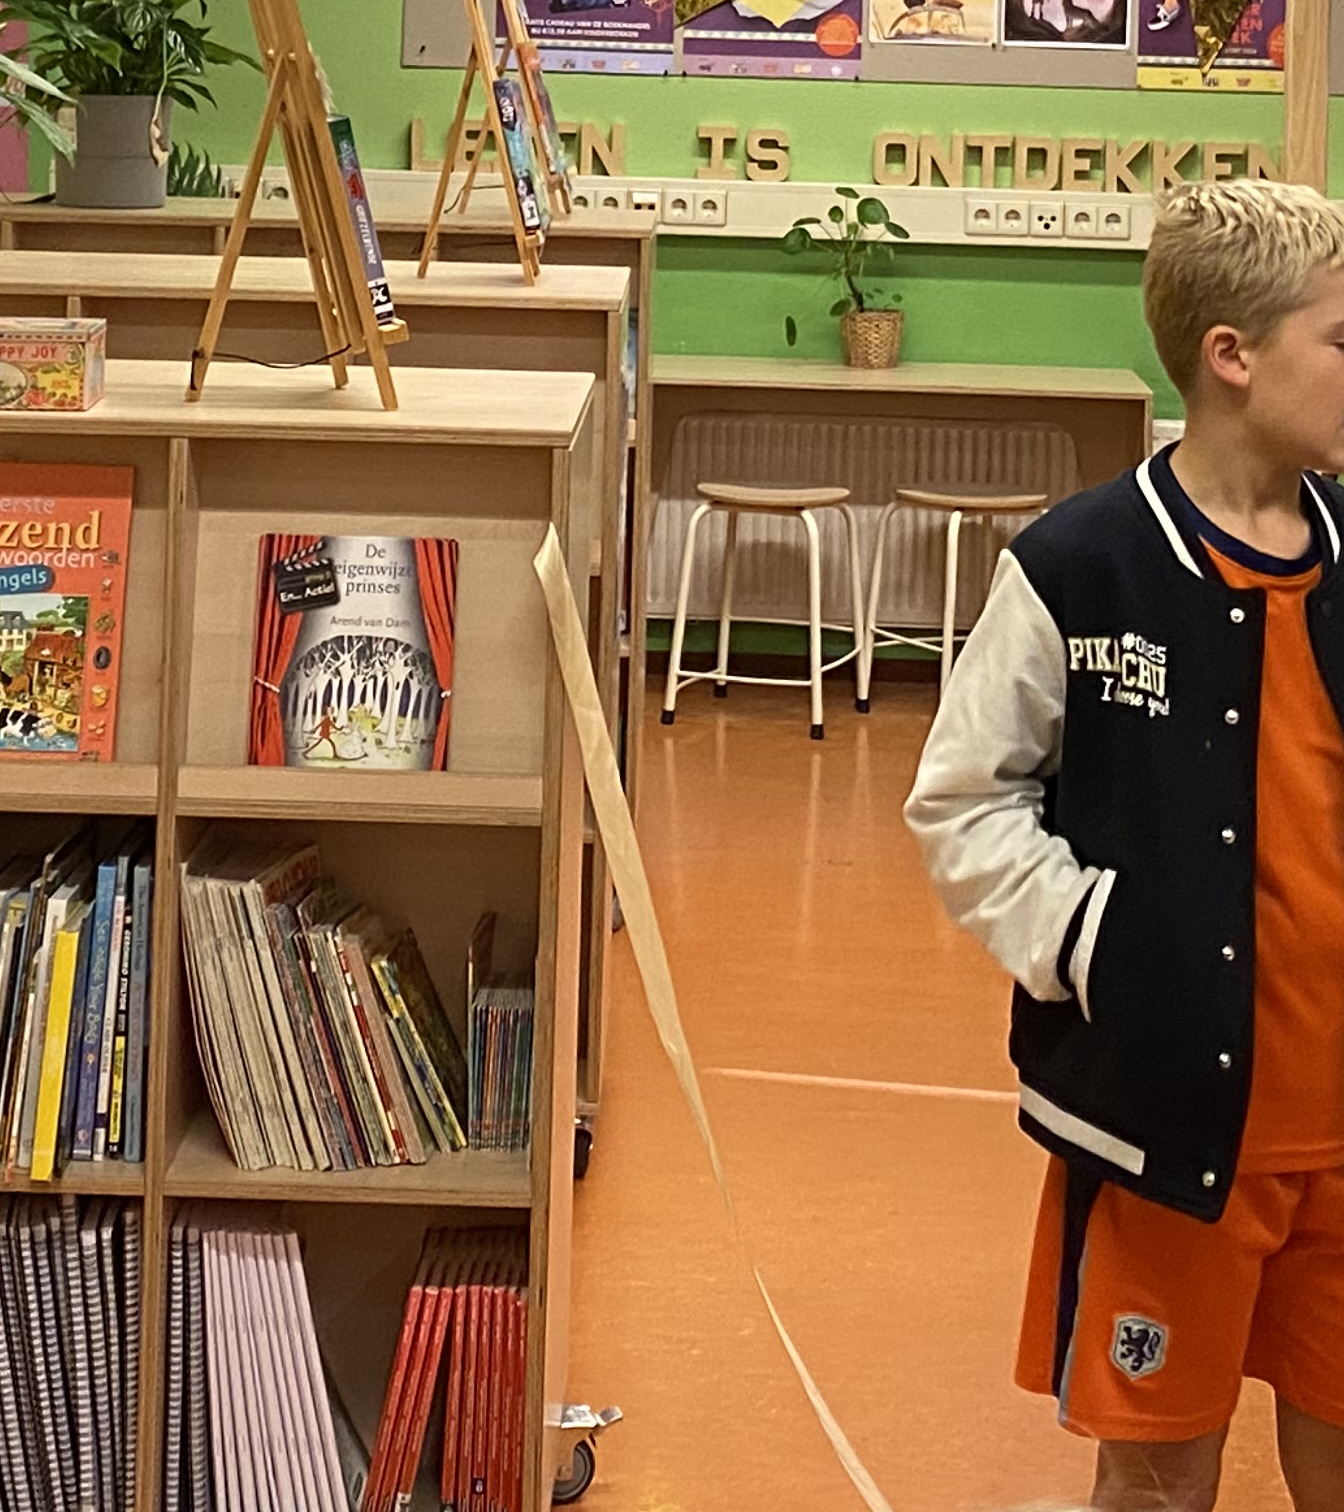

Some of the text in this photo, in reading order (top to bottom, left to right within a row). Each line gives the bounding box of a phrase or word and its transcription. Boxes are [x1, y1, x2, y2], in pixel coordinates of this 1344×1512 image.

[696, 125, 792, 182] IS
[31, 345, 57, 359] JOY
[365, 544, 387, 558] De
[335, 561, 415, 580] eigenwijze
[345, 579, 401, 596] prinses
[330, 615, 411, 627] Arend van Dam
[1122, 652, 1167, 698] CHU
[1100, 675, 1115, 702] I
[122, 929, 132, 976] GERONIMO
